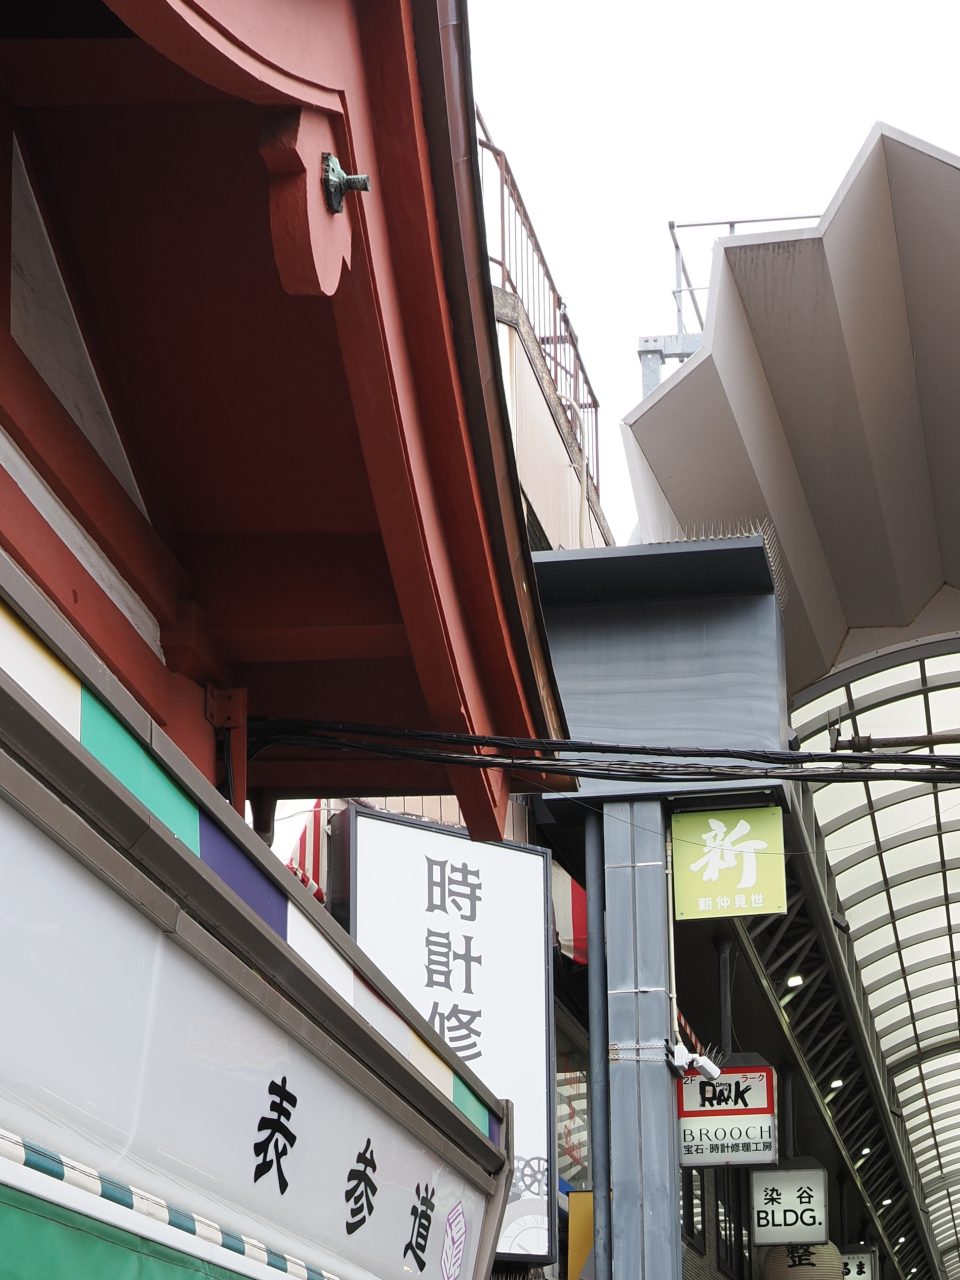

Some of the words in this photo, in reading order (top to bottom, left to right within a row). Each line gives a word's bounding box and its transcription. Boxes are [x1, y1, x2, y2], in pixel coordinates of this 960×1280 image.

[690, 818, 768, 889] 新
[697, 894, 764, 911] 新仲見世
[683, 1076, 697, 1084] 2F
[741, 1074, 765, 1083] ラーク
[683, 1125, 771, 1142] BROOCH
[763, 1186, 814, 1205] 染谷
[756, 1208, 823, 1228] BLDG.
